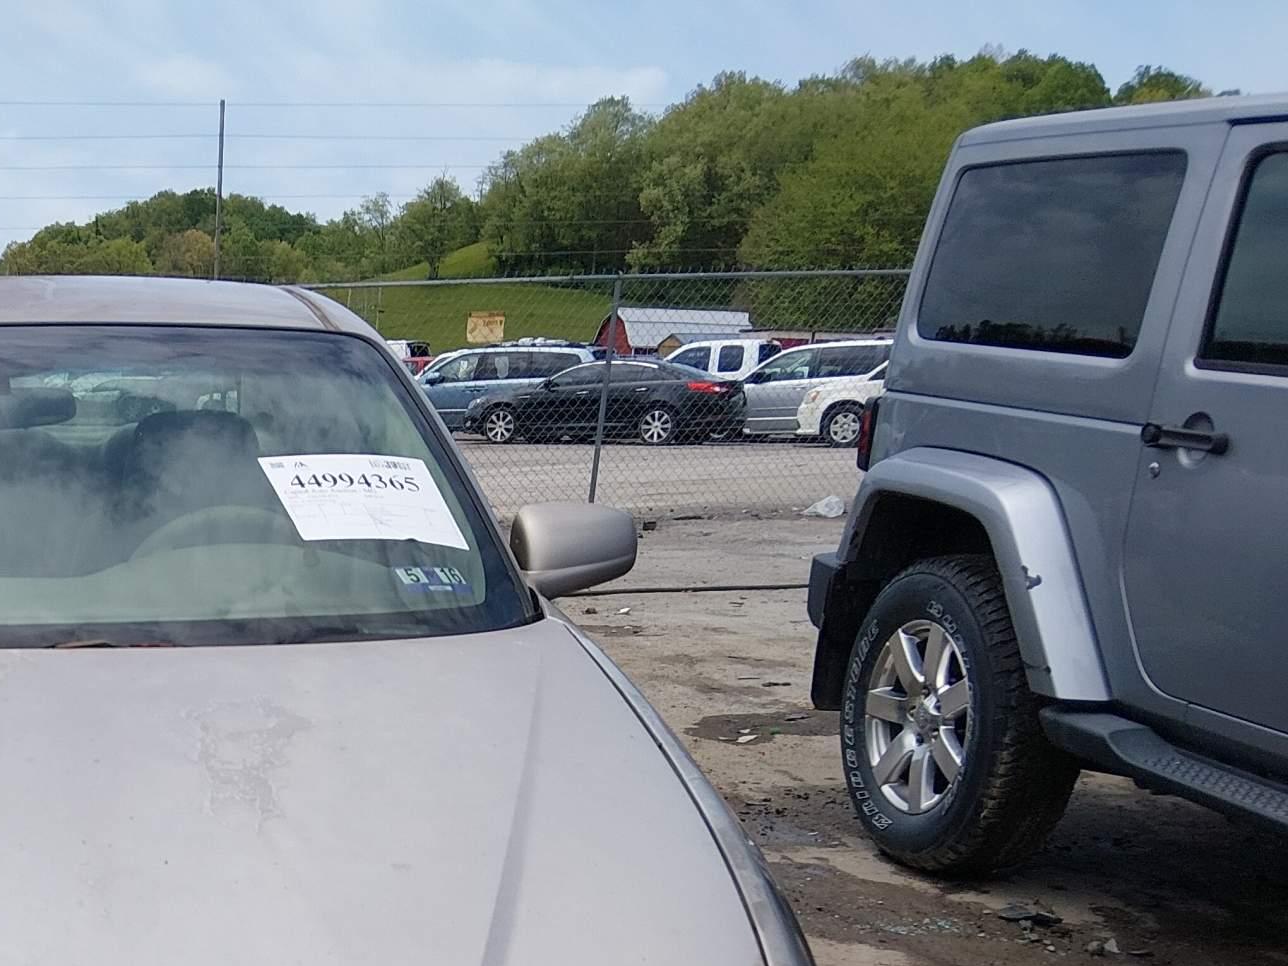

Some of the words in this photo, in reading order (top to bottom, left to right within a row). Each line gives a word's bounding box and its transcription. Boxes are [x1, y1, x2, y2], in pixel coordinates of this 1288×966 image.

[290, 472, 420, 493] 44994365
[404, 567, 420, 583] 5
[440, 567, 462, 584] 16
